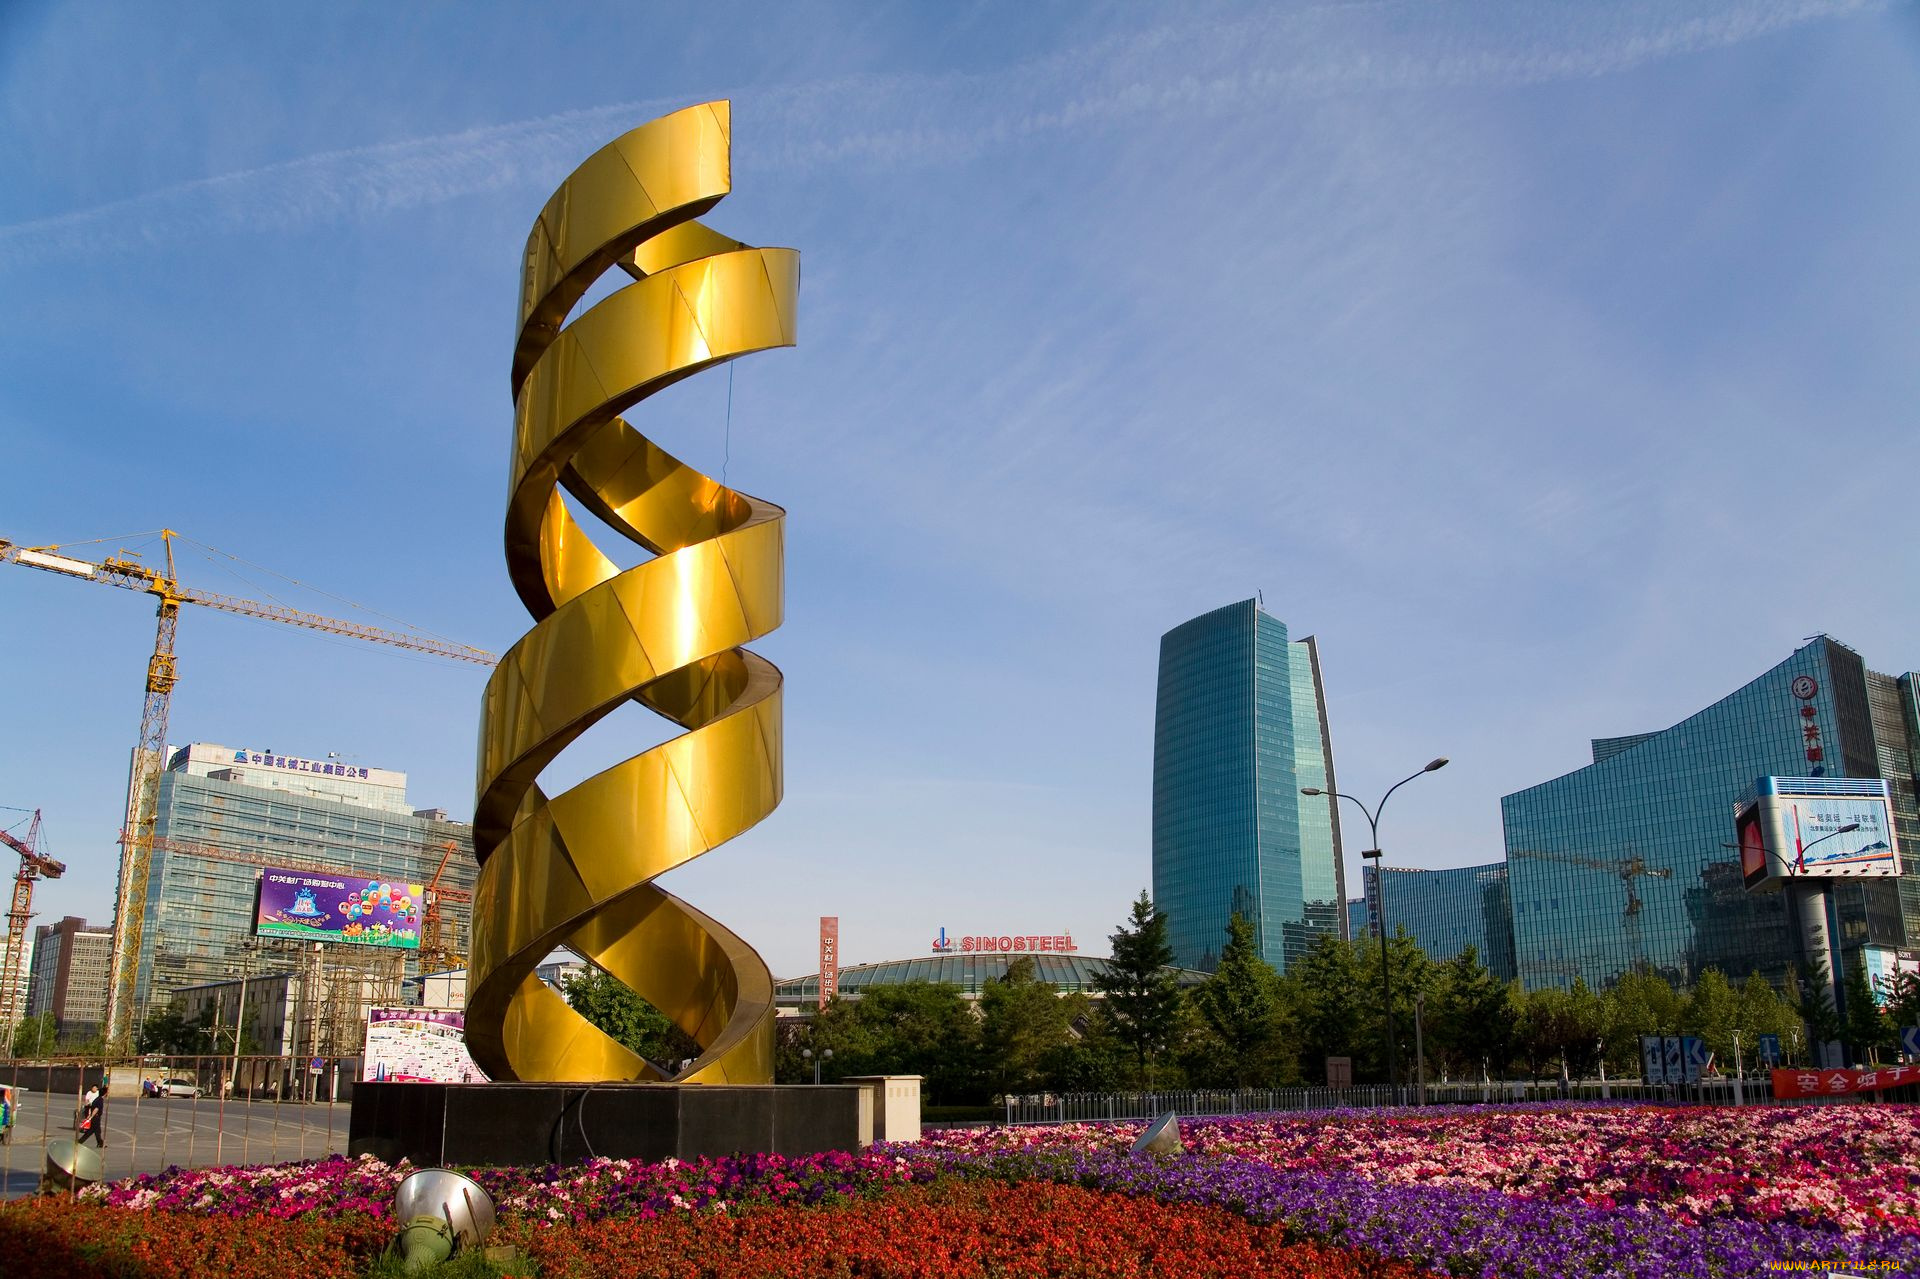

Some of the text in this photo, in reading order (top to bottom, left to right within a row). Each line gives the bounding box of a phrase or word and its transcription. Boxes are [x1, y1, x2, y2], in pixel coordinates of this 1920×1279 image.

[252, 754, 369, 780] 中国机械工业集团公司
[962, 936, 1078, 952] SINOSTEEL
